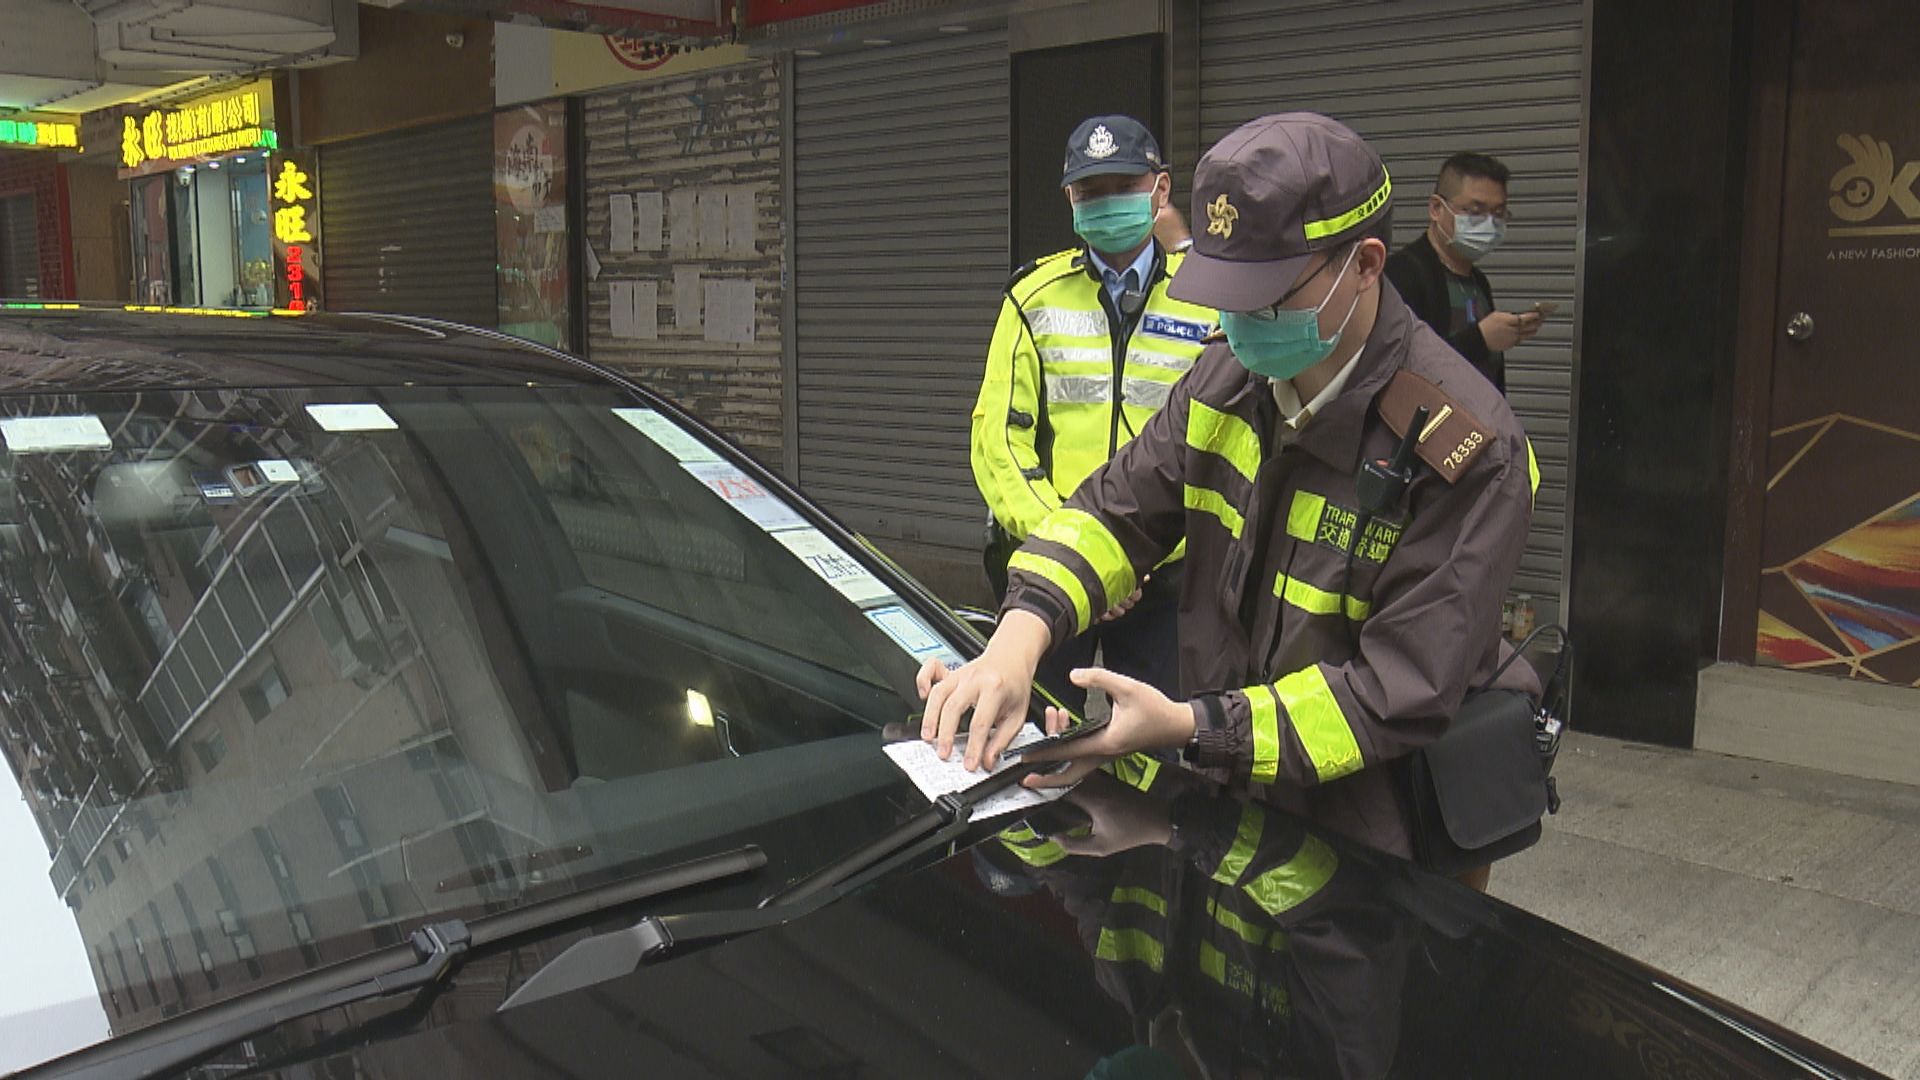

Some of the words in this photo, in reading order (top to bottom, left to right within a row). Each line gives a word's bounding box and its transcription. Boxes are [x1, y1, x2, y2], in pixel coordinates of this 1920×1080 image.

[274, 160, 312, 243] 永旺
[1839, 248, 1868, 260] NEW
[1157, 320, 1194, 337] POLICE
[1443, 431, 1483, 470] 78333
